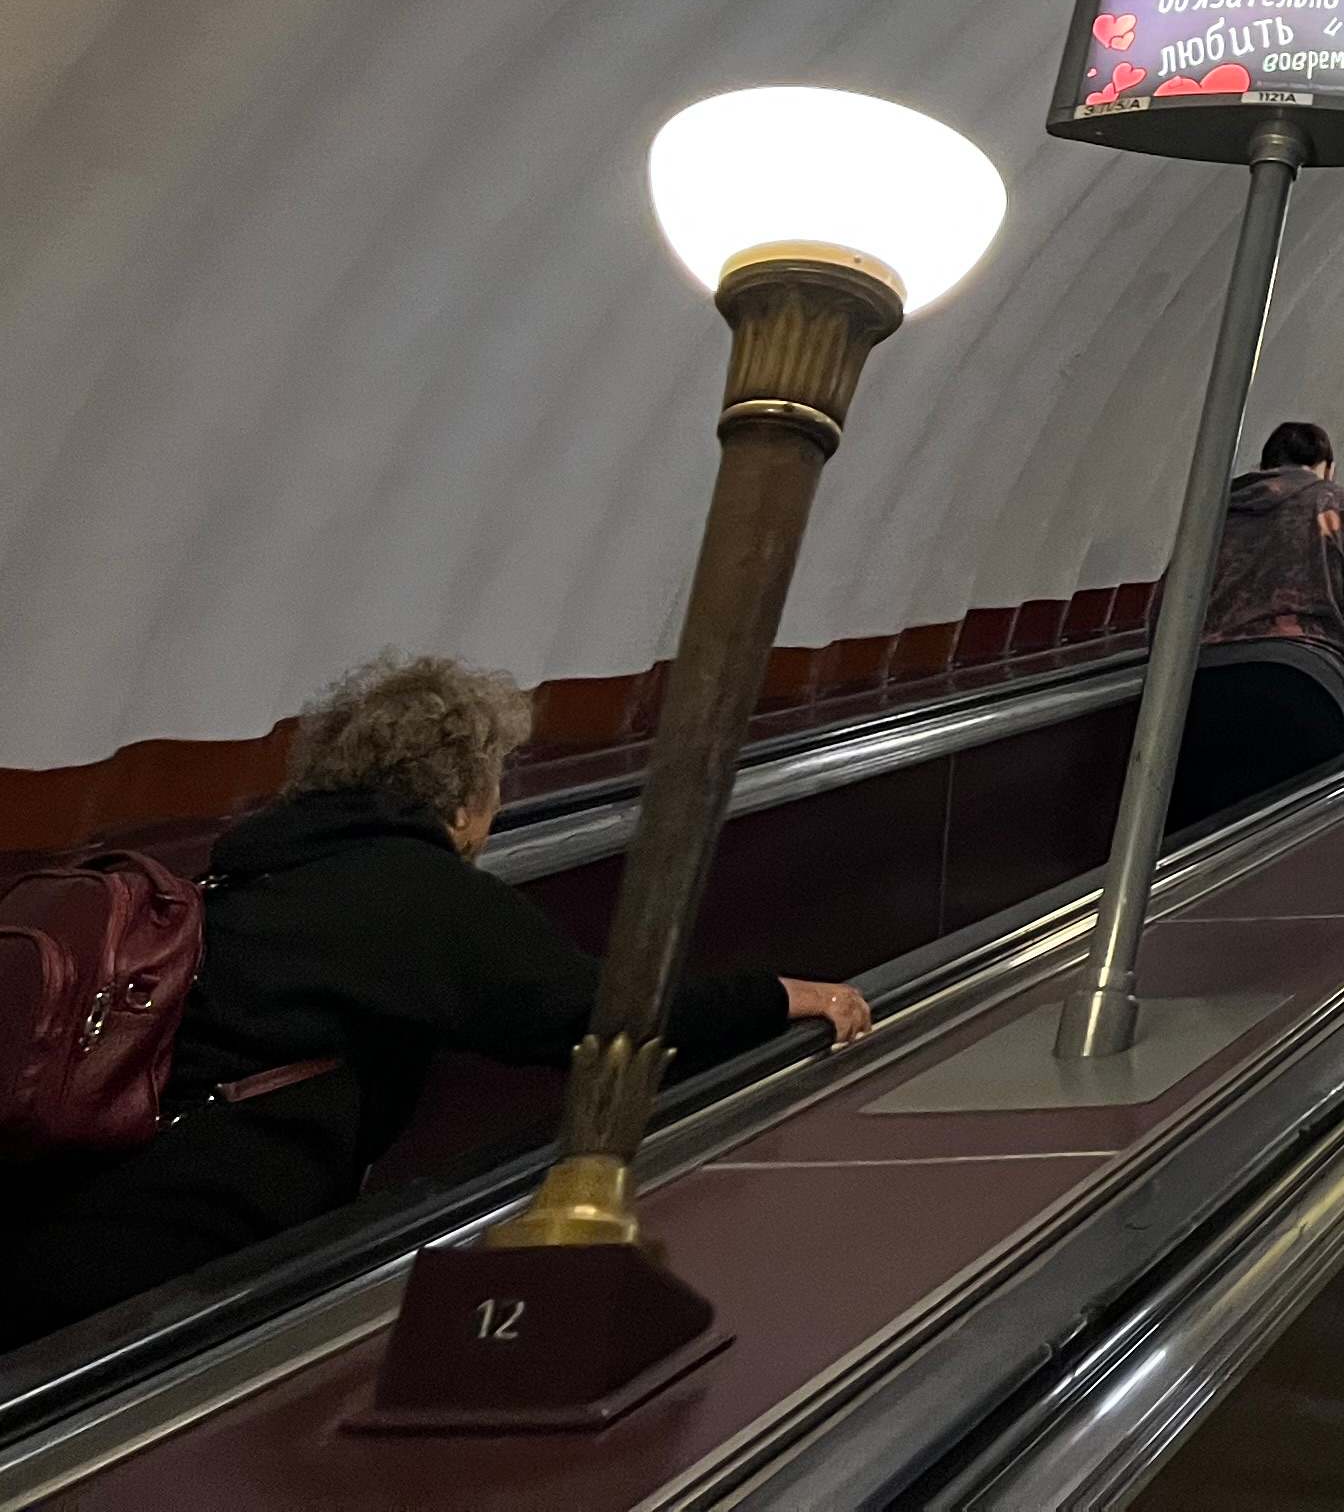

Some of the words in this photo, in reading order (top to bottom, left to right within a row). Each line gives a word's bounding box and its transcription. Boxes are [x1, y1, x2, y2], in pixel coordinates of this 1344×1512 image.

[1158, 16, 1295, 77] любить
[1322, 16, 1344, 37] и
[476, 1298, 525, 1339] 12
